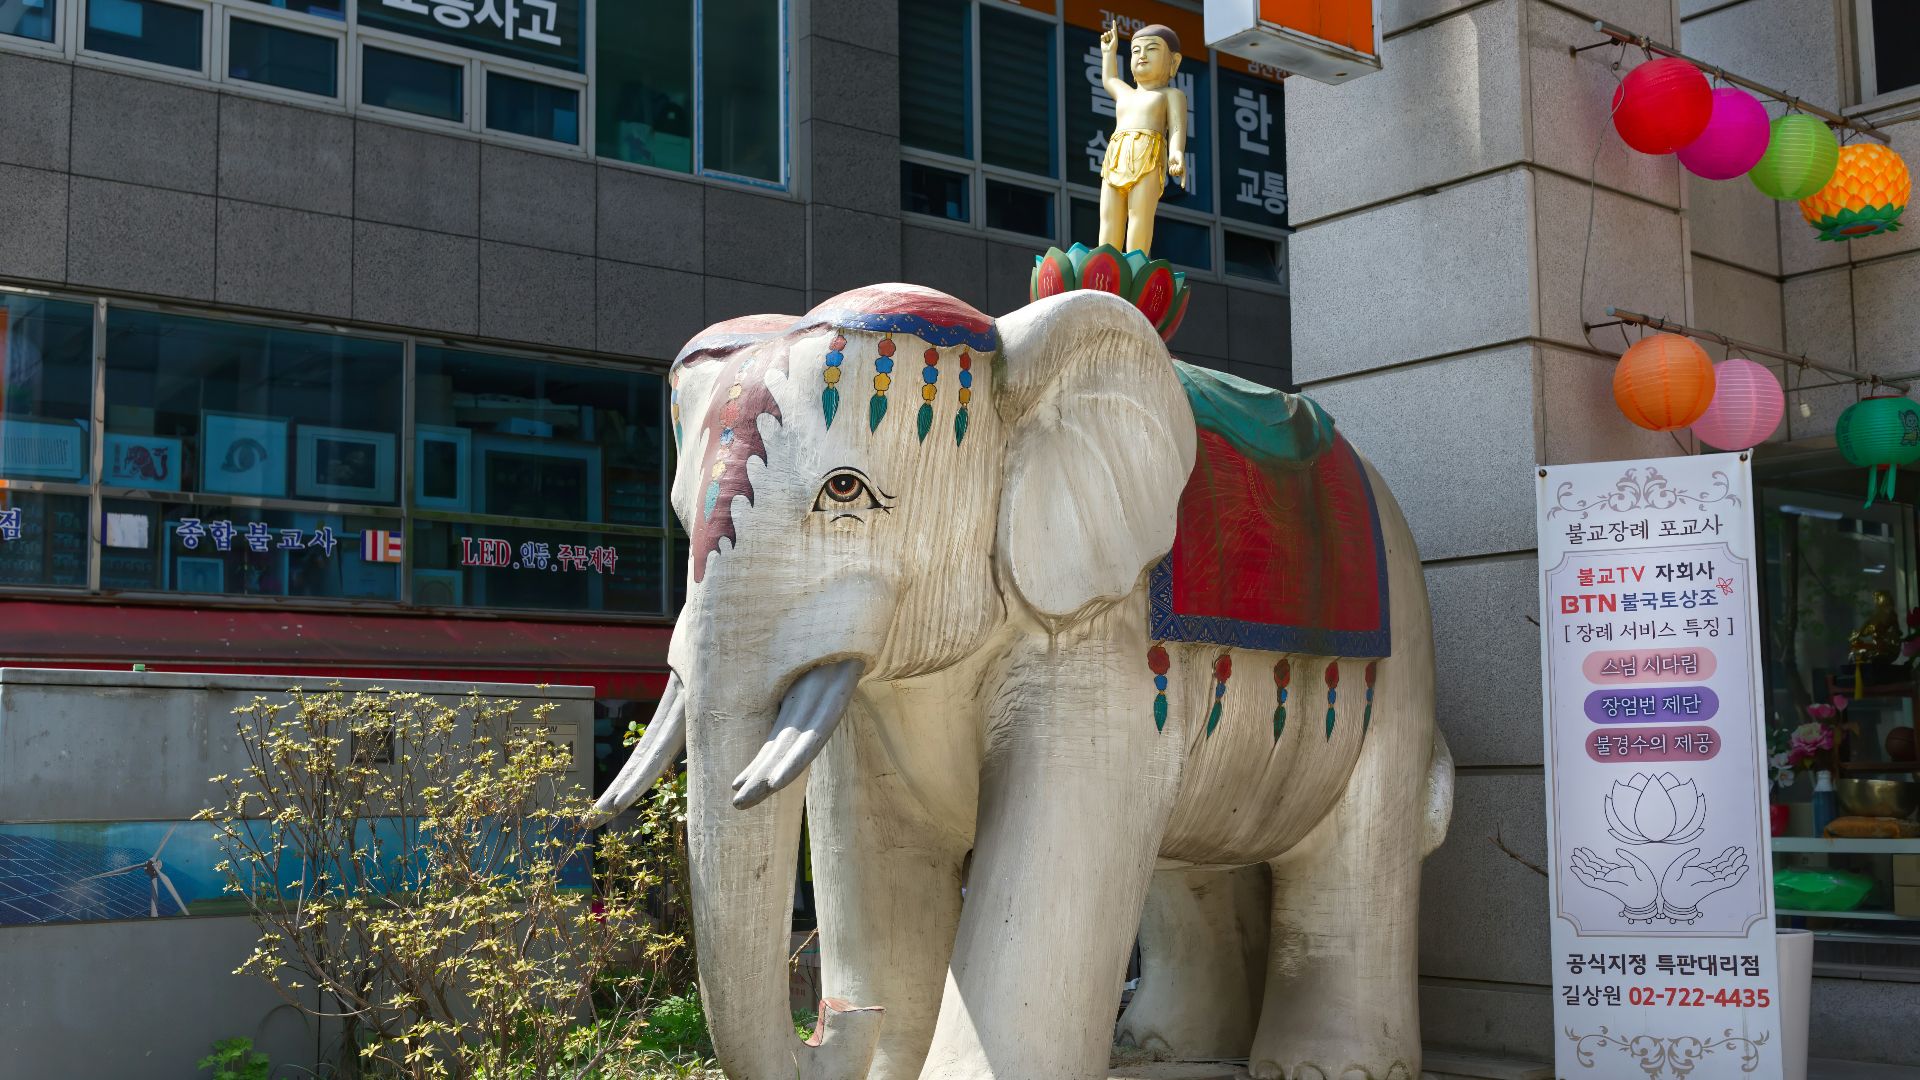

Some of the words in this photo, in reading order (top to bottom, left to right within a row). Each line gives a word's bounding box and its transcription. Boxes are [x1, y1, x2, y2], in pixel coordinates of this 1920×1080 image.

[1565, 518, 1649, 545] 불교장례
[1658, 513, 1723, 536] 포교사
[1577, 565, 1645, 587] 불교TV
[1655, 560, 1715, 582] 자회사
[1560, 593, 1617, 615] BTN
[1620, 620, 1677, 641] 서비스
[1601, 656, 1636, 677] 스님
[1643, 653, 1697, 675] 시다림
[1602, 695, 1656, 717] 장엄번
[1662, 693, 1702, 715] 제단
[1593, 733, 1666, 756] 불경수의
[1674, 732, 1714, 754] 제공
[1566, 953, 1647, 976] 공식지정
[1655, 953, 1760, 977] 특판대리점
[1562, 985, 1621, 1007] 길상원
[1628, 986, 1771, 1008] 02-722-4435
